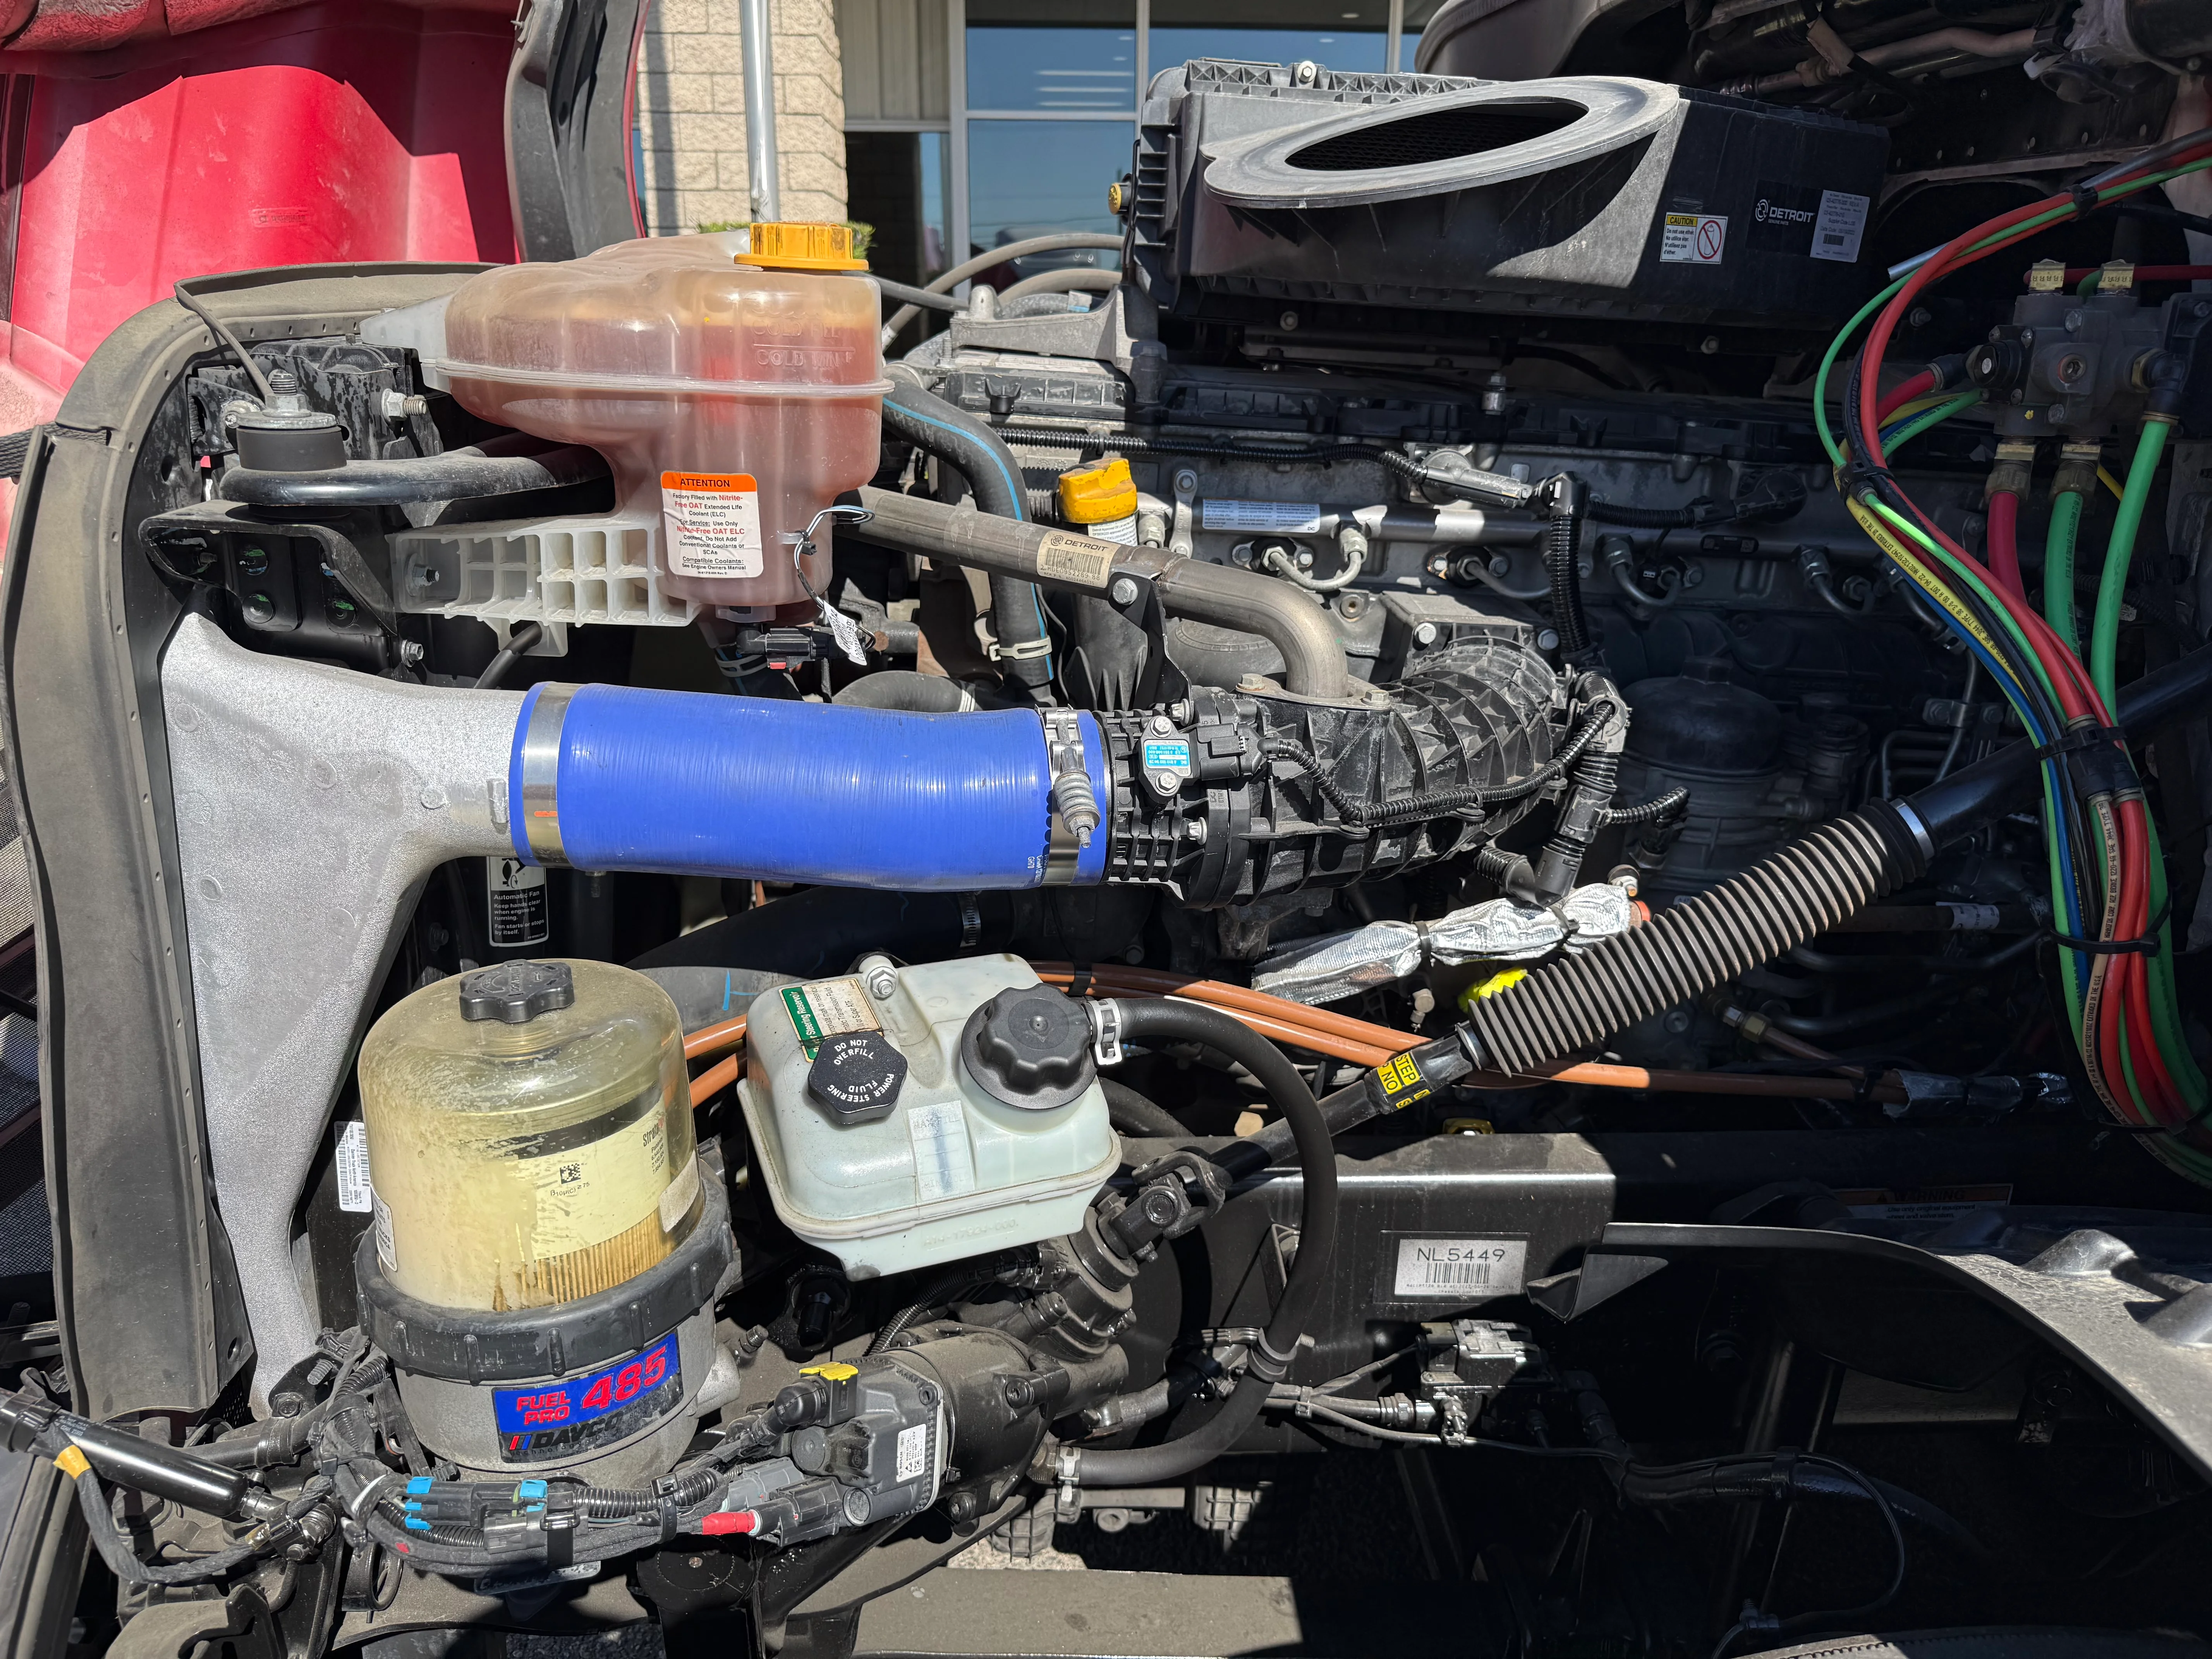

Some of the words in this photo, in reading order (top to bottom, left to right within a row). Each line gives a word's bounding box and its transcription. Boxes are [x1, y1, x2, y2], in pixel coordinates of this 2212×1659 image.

[1768, 207, 1815, 223] DETROIT
[752, 319, 802, 337] COLD
[756, 350, 804, 366] COLD
[680, 479, 730, 487] ATTENTION
[1866, 522, 1875, 531] THE
[1065, 539, 1109, 551] DETROIT
[1875, 533, 1894, 550] EXTRUDED
[1930, 584, 1940, 594] DOT
[1961, 613, 1975, 626] TYPE
[1972, 623, 1984, 636] J844
[1982, 634, 1992, 644] SAE
[2102, 812, 2112, 825] TYPE
[790, 991, 807, 1014] Reservoir
[830, 995, 845, 1021] Transmission
[821, 1007, 829, 1017] mark
[850, 1007, 860, 1018] Super
[2087, 1002, 2095, 1022] EXTRUDED
[802, 1014, 816, 1036] Steering
[834, 1042, 847, 1052] DO
[834, 1048, 874, 1065] OVERFILL
[1396, 1054, 1416, 1081] STEP
[848, 1080, 878, 1092] FLUID
[874, 1073, 894, 1097] POWER
[1382, 1071, 1398, 1090] NO
[827, 1085, 870, 1102] STEERING
[1417, 1247, 1505, 1262] NL5449
[517, 1391, 571, 1411] FUEL
[582, 1345, 667, 1410] 485
[524, 1406, 570, 1425] PRO
[532, 1412, 623, 1449] DAYCO
